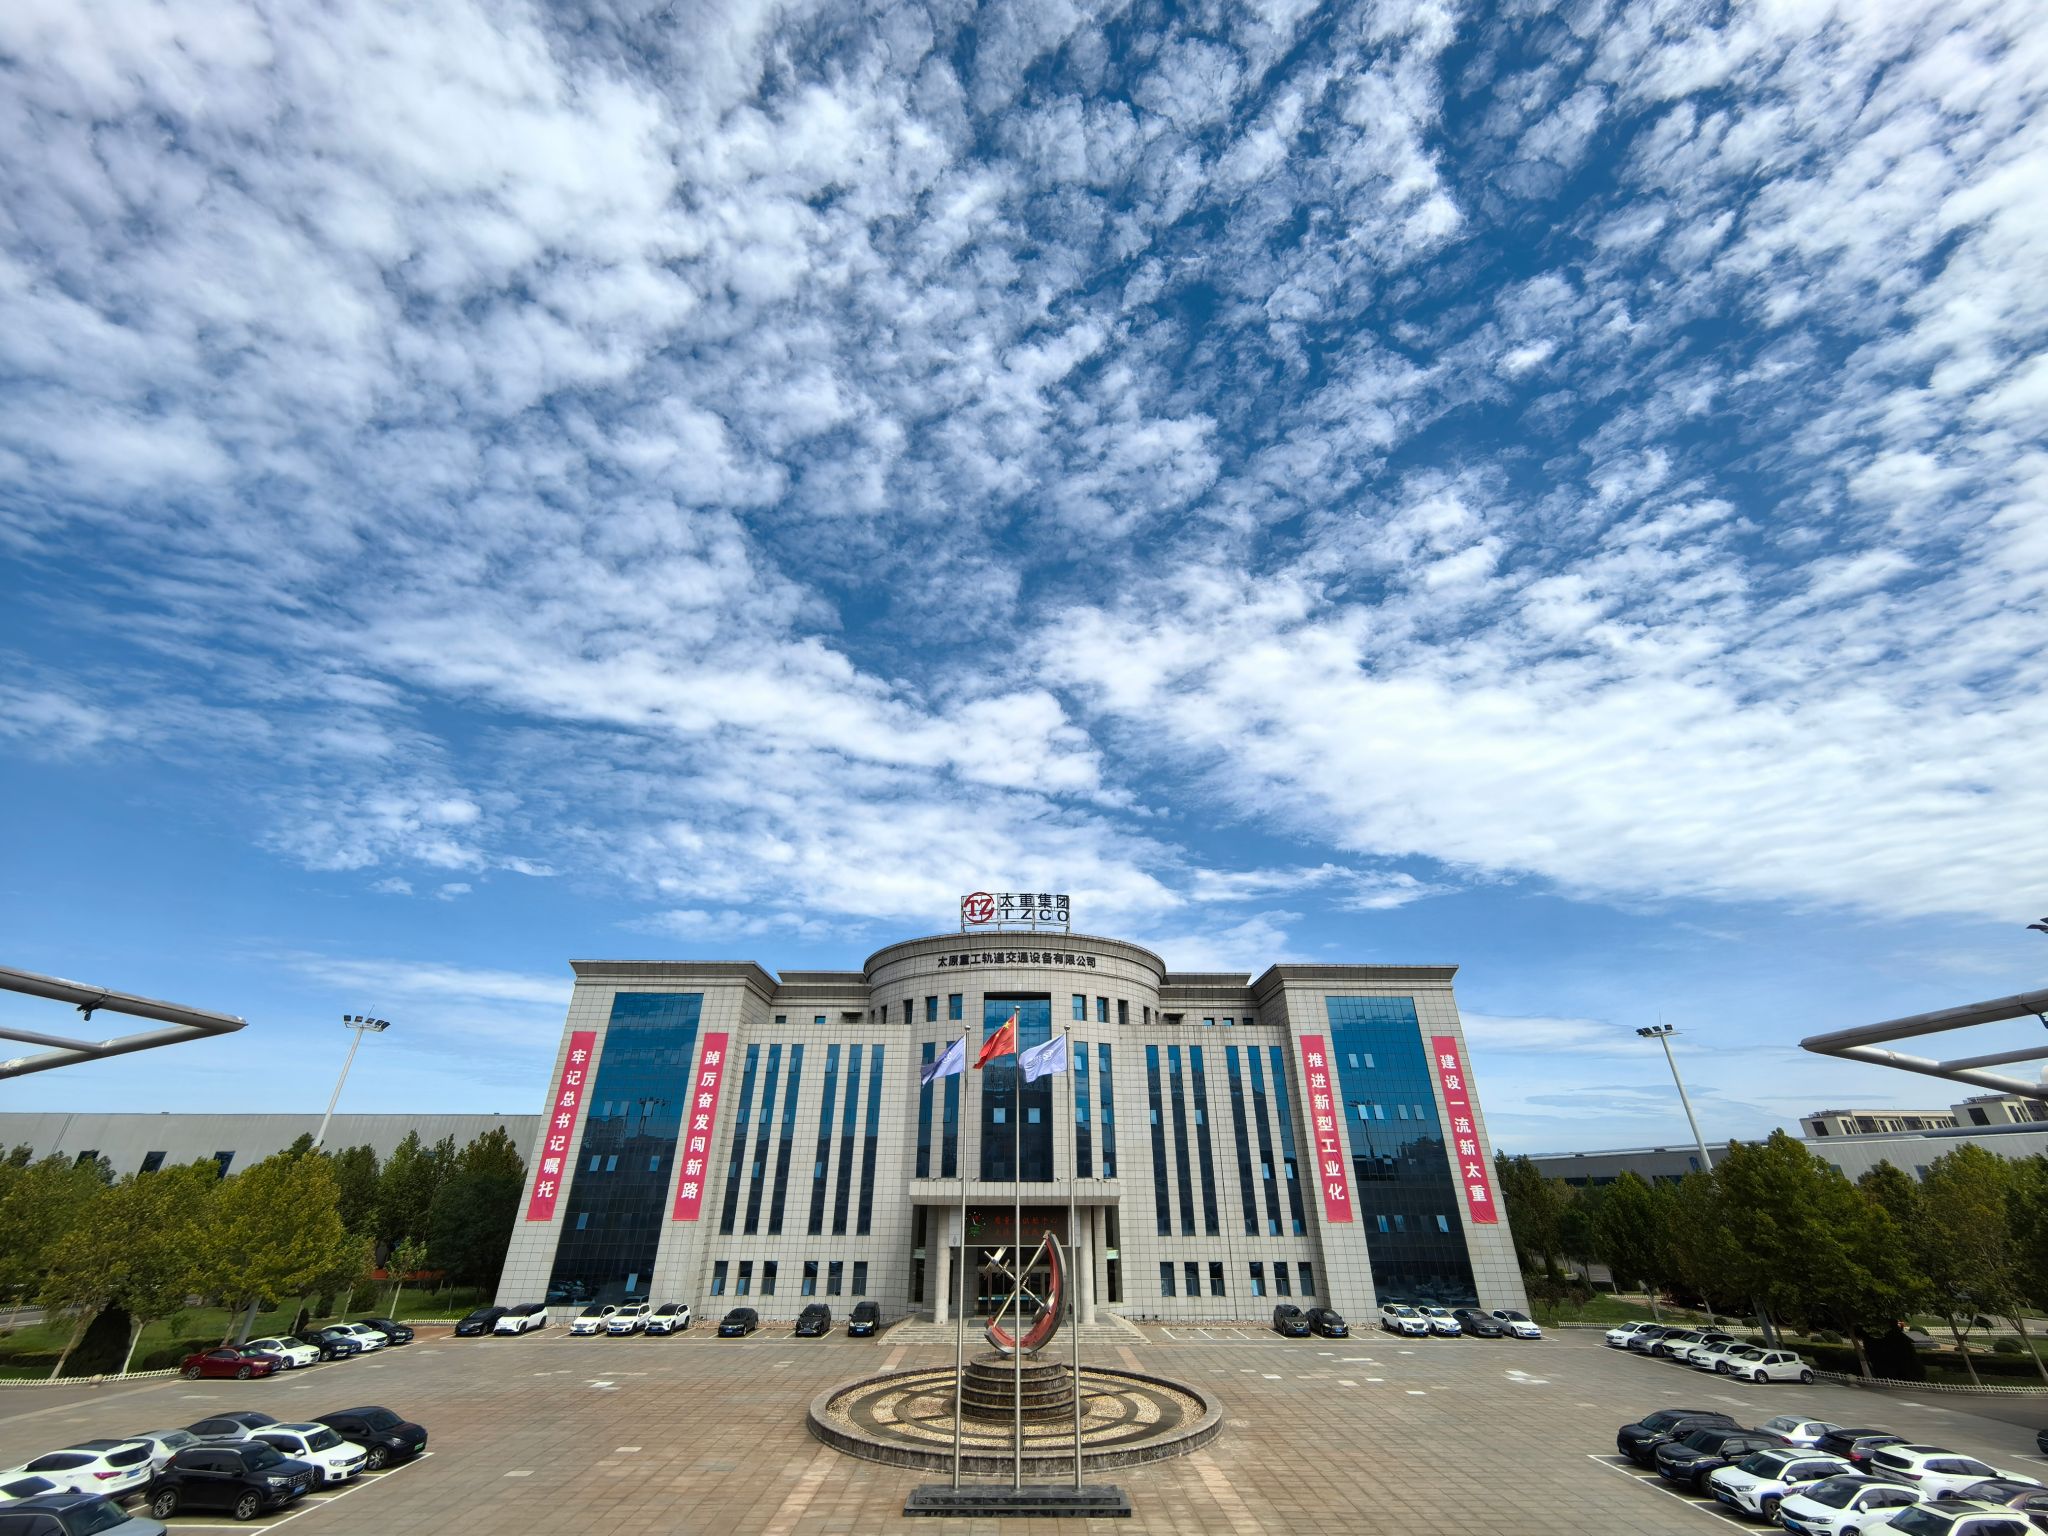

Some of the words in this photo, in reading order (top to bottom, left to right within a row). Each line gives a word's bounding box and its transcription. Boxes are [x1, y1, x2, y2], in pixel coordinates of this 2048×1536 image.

[938, 951, 1096, 968] 太原重工轨道交通设备有限公司
[1000, 893, 1070, 909] 太重集团
[1001, 909, 1070, 921] TZCO
[538, 1049, 587, 1198] 牢记总书记嘱托
[681, 1050, 721, 1200] 踔厉奋发闯新路
[1307, 1052, 1345, 1201] 推进新型工业化
[1440, 1054, 1487, 1202] 建设一流新太重
